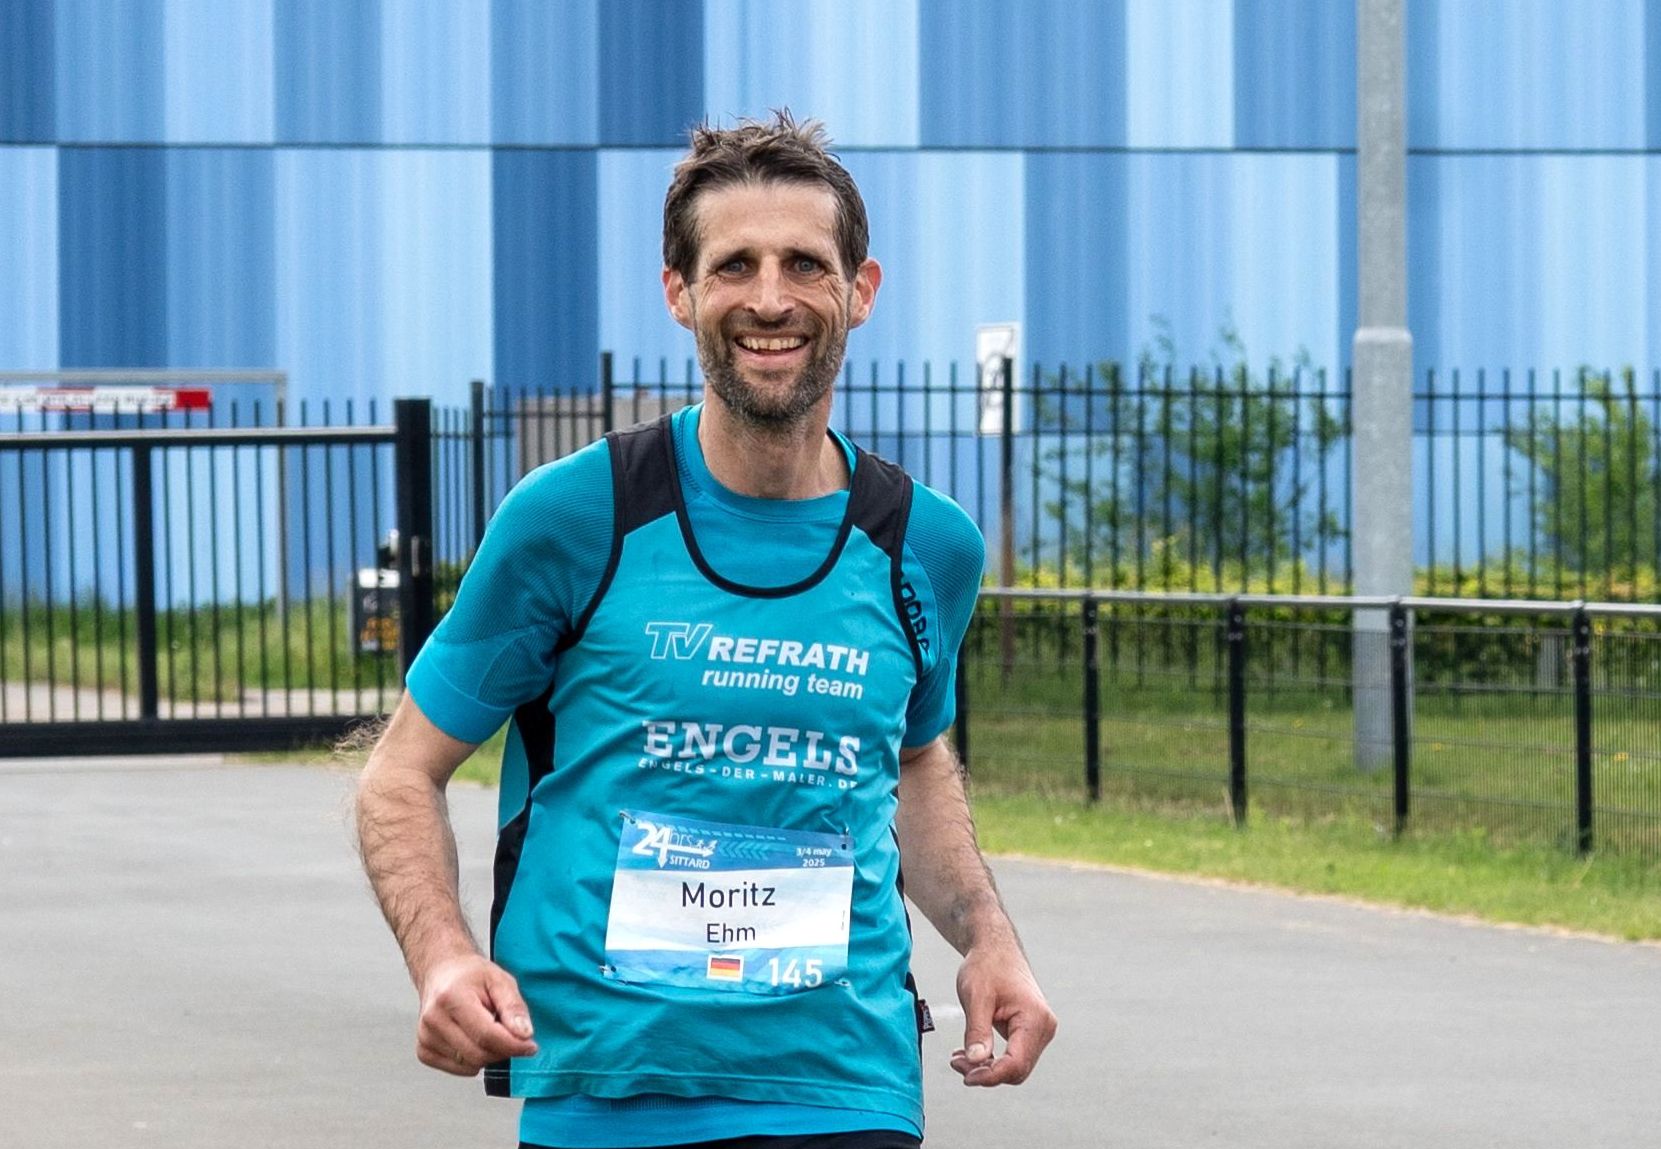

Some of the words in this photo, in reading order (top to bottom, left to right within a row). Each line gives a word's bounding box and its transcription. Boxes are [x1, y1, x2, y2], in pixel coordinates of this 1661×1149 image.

[645, 622, 713, 660] TV
[707, 636, 870, 676] REFRATH
[701, 668, 800, 696] running
[807, 672, 864, 700] team
[642, 720, 861, 776] ENGELS
[669, 855, 710, 870] SITTARD
[802, 858, 825, 867] 2025
[812, 847, 832, 857] may
[681, 881, 777, 908] Moritz
[706, 923, 757, 944] Ehm
[768, 957, 823, 989] 145
